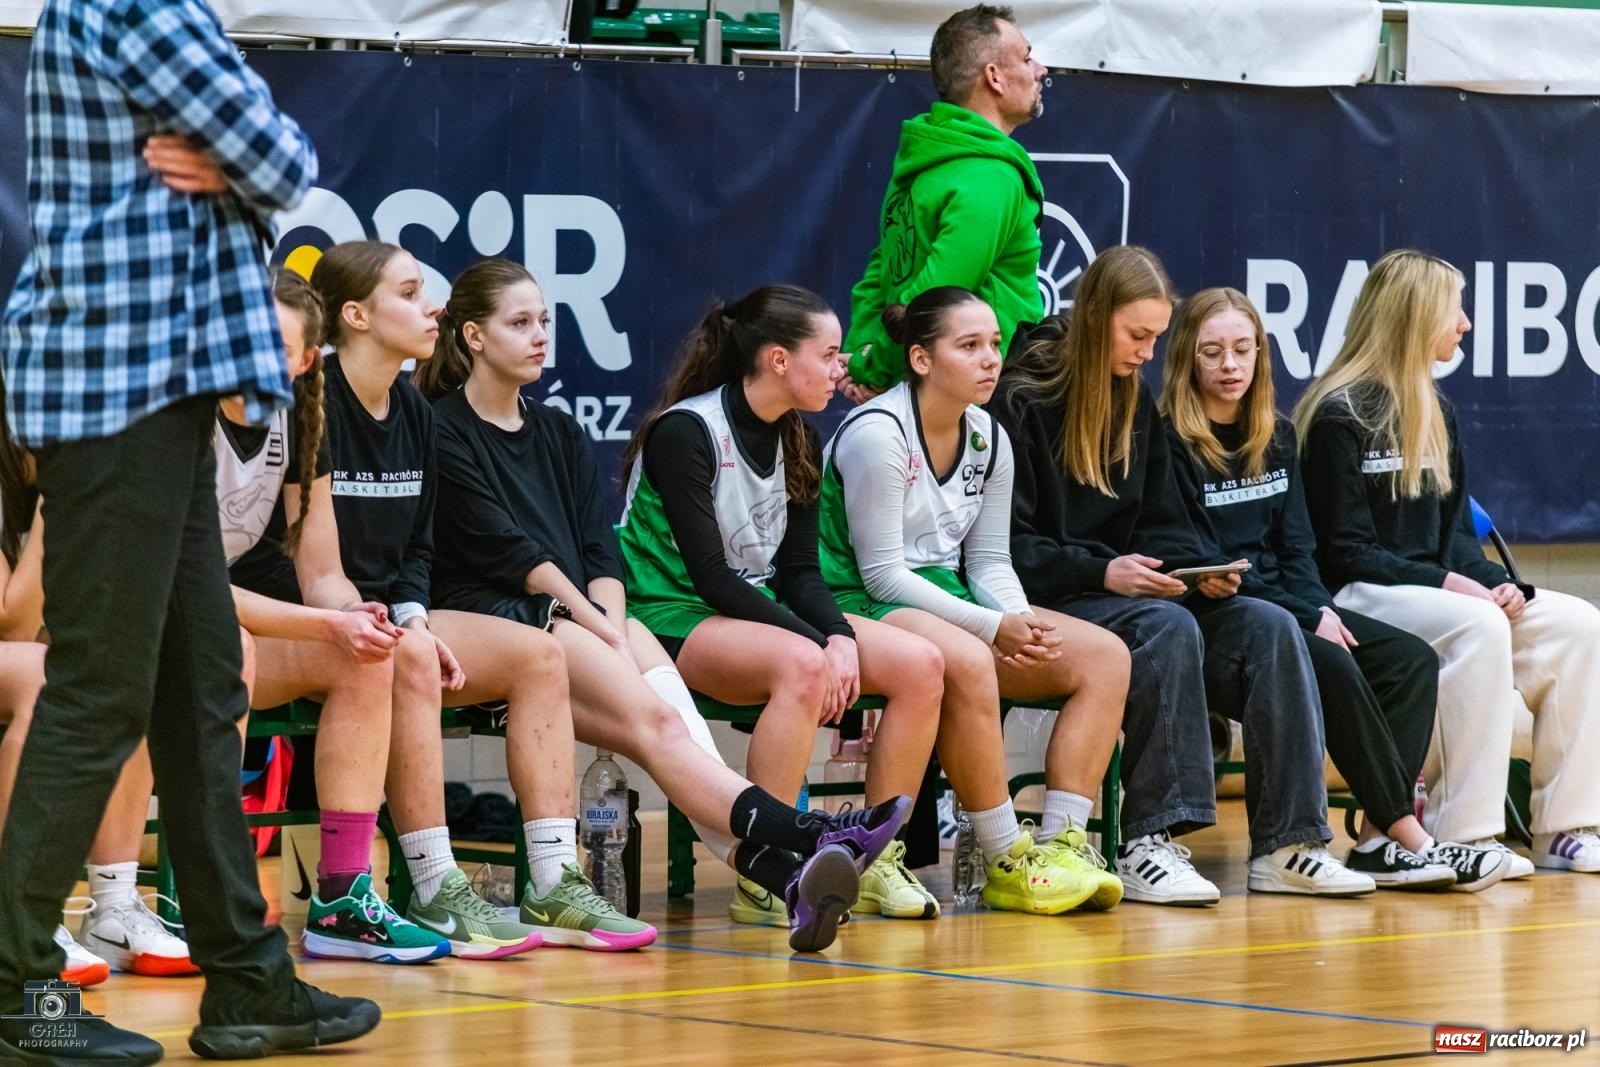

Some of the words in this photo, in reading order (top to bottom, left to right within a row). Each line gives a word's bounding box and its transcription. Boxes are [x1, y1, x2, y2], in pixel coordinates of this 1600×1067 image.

[1246, 258, 1600, 379] RAIB
[355, 471, 374, 481] AZS
[1222, 479, 1238, 490] AZS
